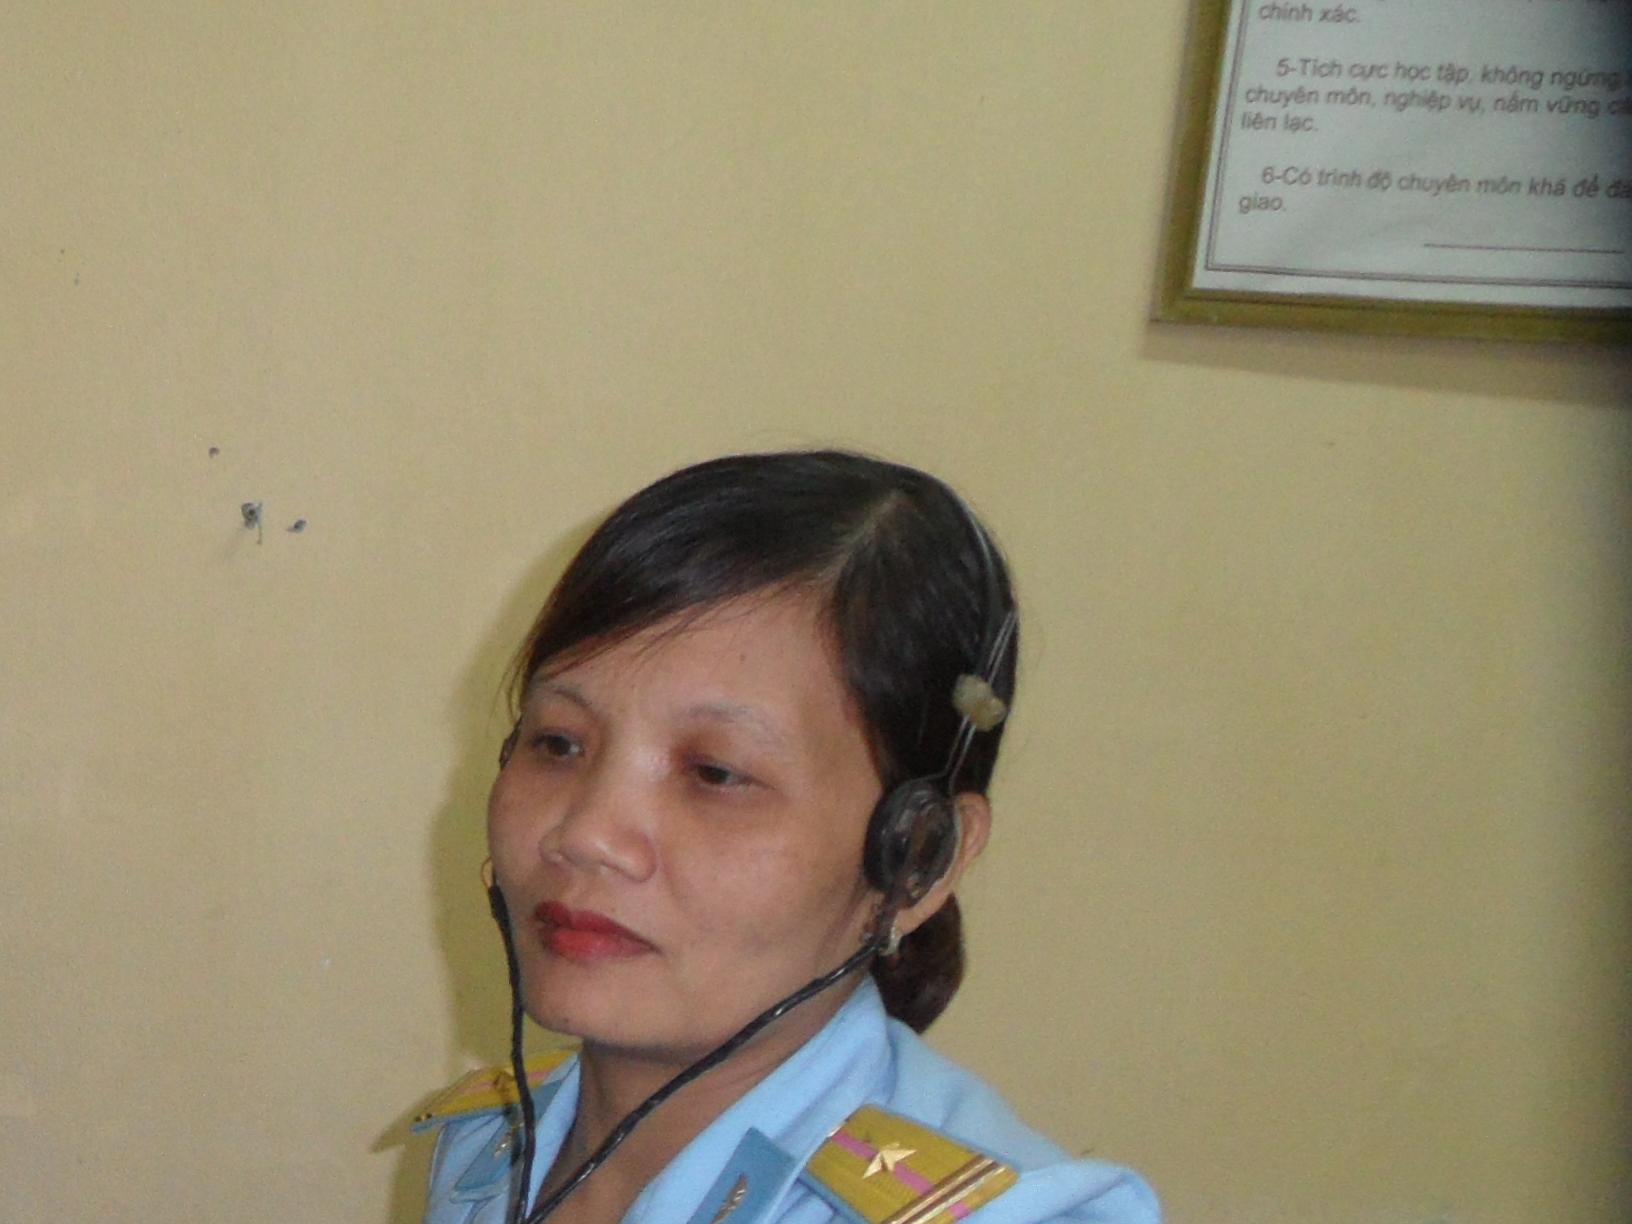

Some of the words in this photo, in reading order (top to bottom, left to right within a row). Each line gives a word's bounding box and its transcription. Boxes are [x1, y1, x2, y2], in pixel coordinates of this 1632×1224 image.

[1259, 2, 1313, 21] chính
[1348, 62, 1388, 81] cực
[1396, 61, 1431, 80] học
[1481, 65, 1544, 90] không
[1246, 85, 1318, 107] chuyên
[1384, 89, 1451, 113] nghiệp
[1241, 113, 1276, 130] liên
[1398, 173, 1470, 196] chuyên
[1477, 175, 1521, 193] môn
[1239, 193, 1287, 214] giao.
